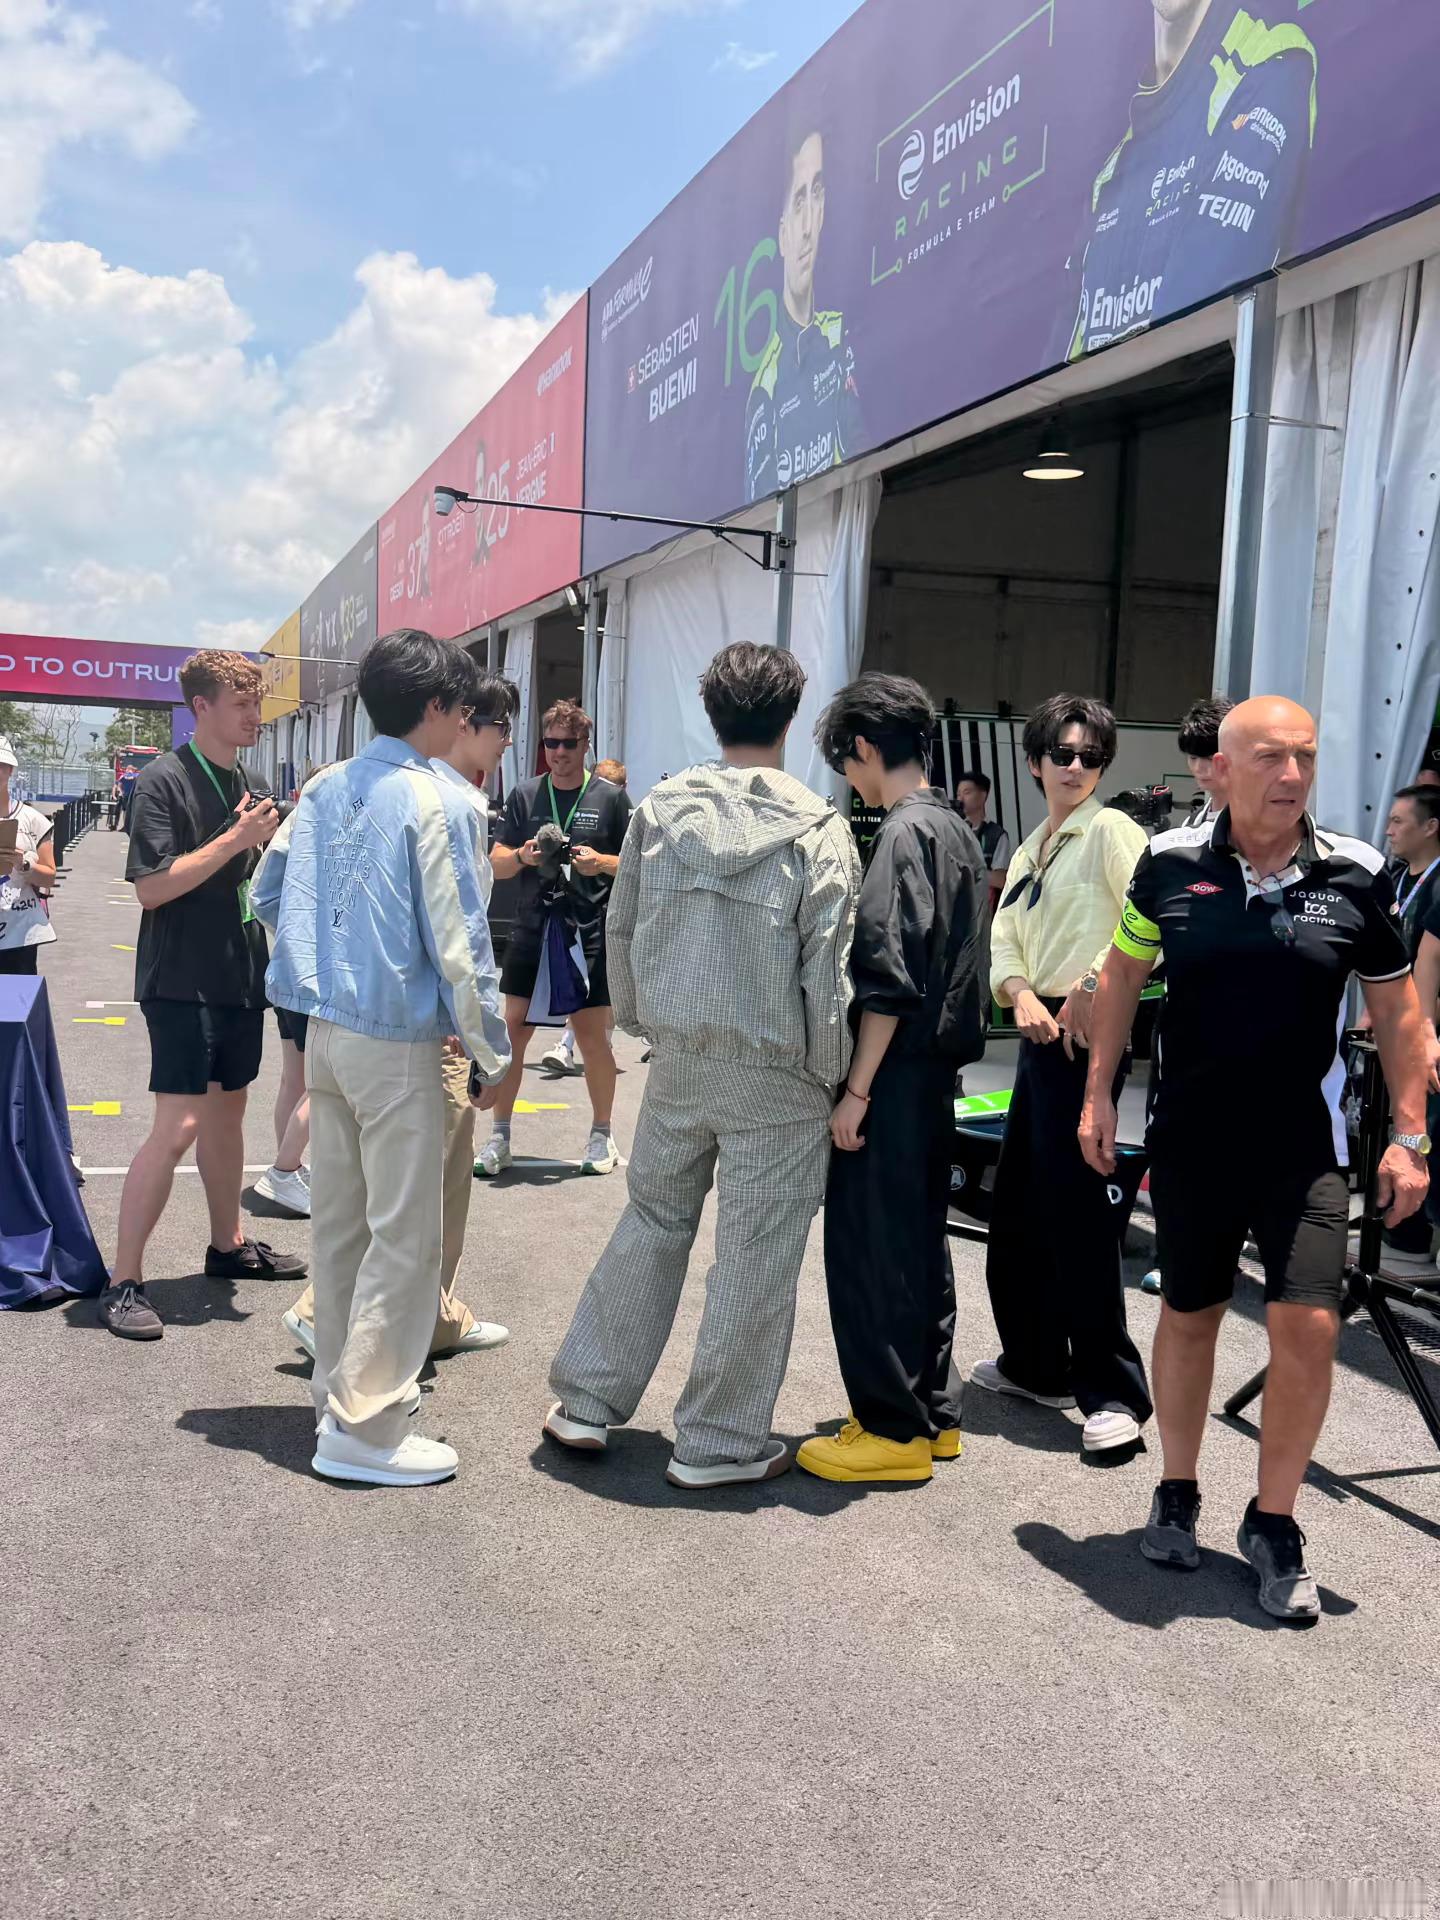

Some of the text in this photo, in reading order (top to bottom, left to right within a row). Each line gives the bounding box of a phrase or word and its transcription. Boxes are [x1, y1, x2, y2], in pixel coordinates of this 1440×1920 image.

[932, 74, 1020, 164] Envision
[895, 135, 1017, 240] RACING
[1198, 194, 1255, 233] TEIJIN
[907, 196, 996, 264] FORMULA E TEAM
[638, 312, 700, 386] SÉBASTIEN
[713, 237, 777, 387] 16
[649, 357, 697, 423] BUEMI
[484, 459, 511, 547] 25
[24, 656, 65, 676] TO
